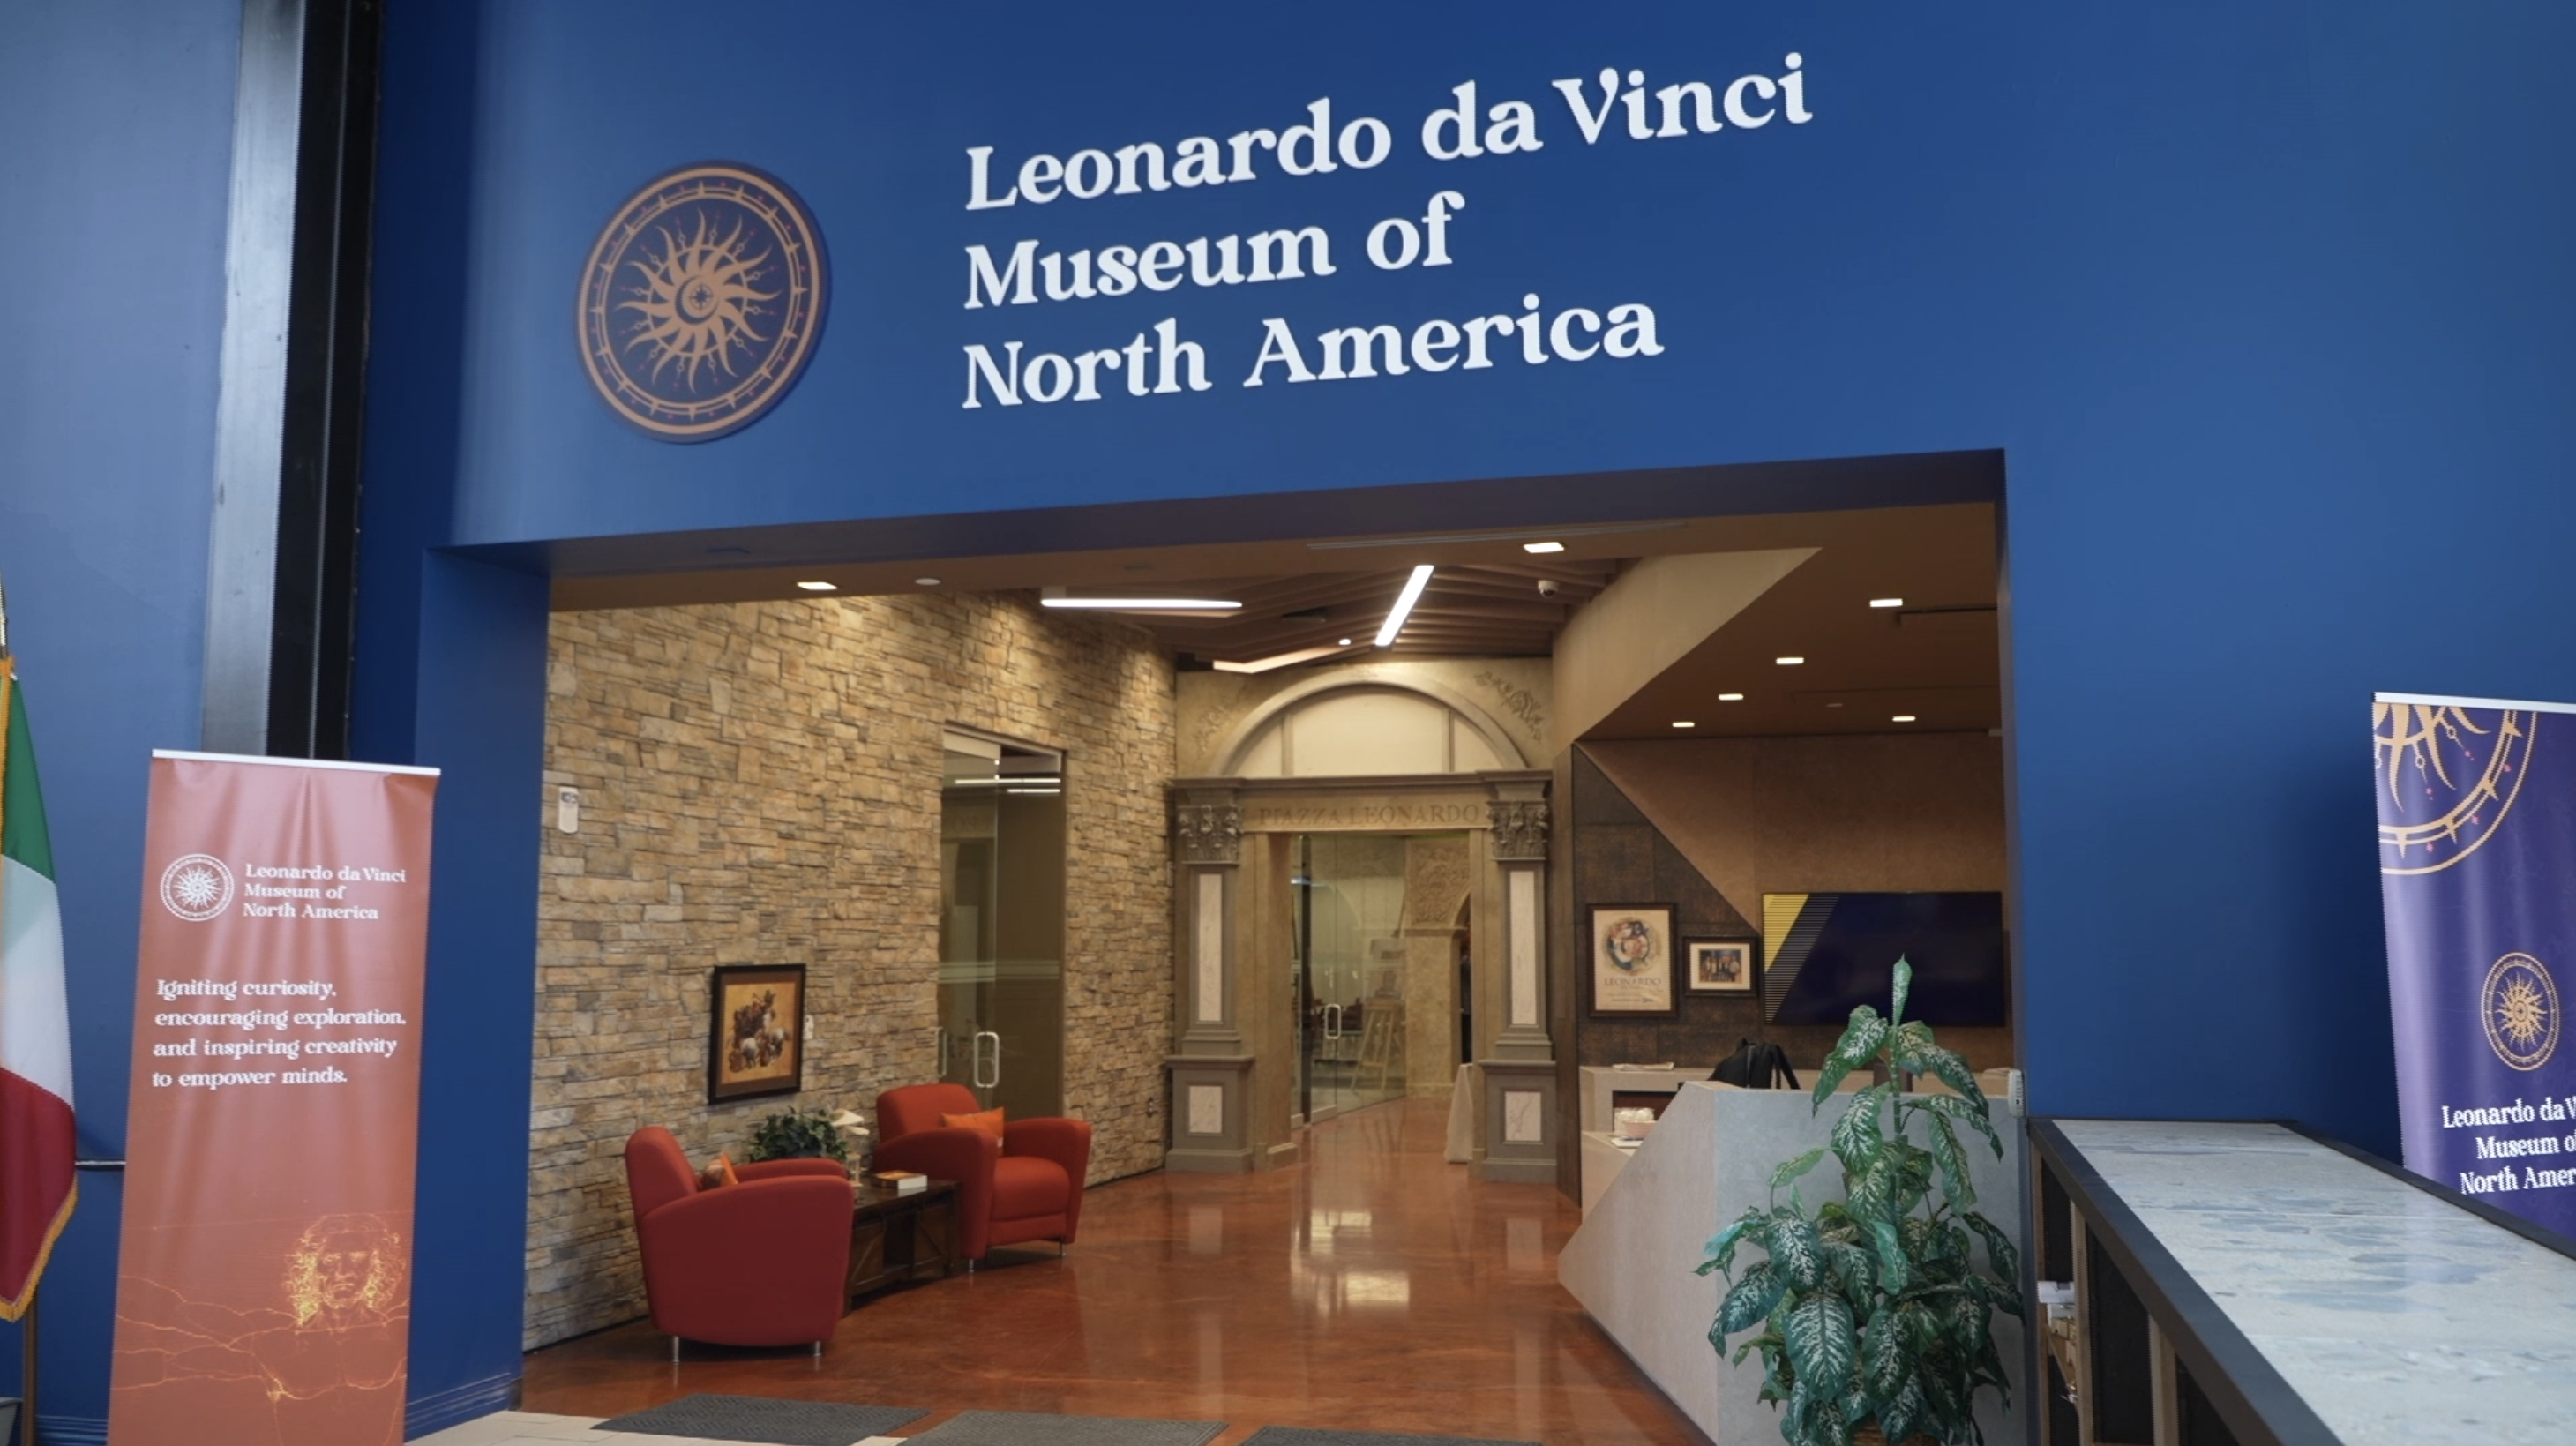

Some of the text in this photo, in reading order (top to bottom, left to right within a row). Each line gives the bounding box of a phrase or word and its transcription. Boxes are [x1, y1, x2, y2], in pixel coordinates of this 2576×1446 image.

[965, 52, 1813, 211] Leonardo da Vinci
[964, 191, 1465, 309] Museum of
[962, 293, 1665, 408] North America
[1259, 804, 1479, 826] PIAZZA LEONARDO
[245, 864, 407, 883] Leonardo da Vinci
[244, 883, 347, 899] Museum of
[243, 902, 379, 920] North America
[156, 979, 238, 1001] Igniting
[1604, 977, 1662, 987] LEONARDO
[154, 1009, 289, 1030] encouraging
[153, 1037, 398, 1060] and inspiring creativity
[152, 1065, 348, 1090] to empower minds.
[2441, 1098, 2535, 1128] Leonardo
[2539, 1096, 2566, 1121] da
[2475, 1129, 2576, 1160] Museum o
[2459, 1165, 2576, 1195] North Amer
